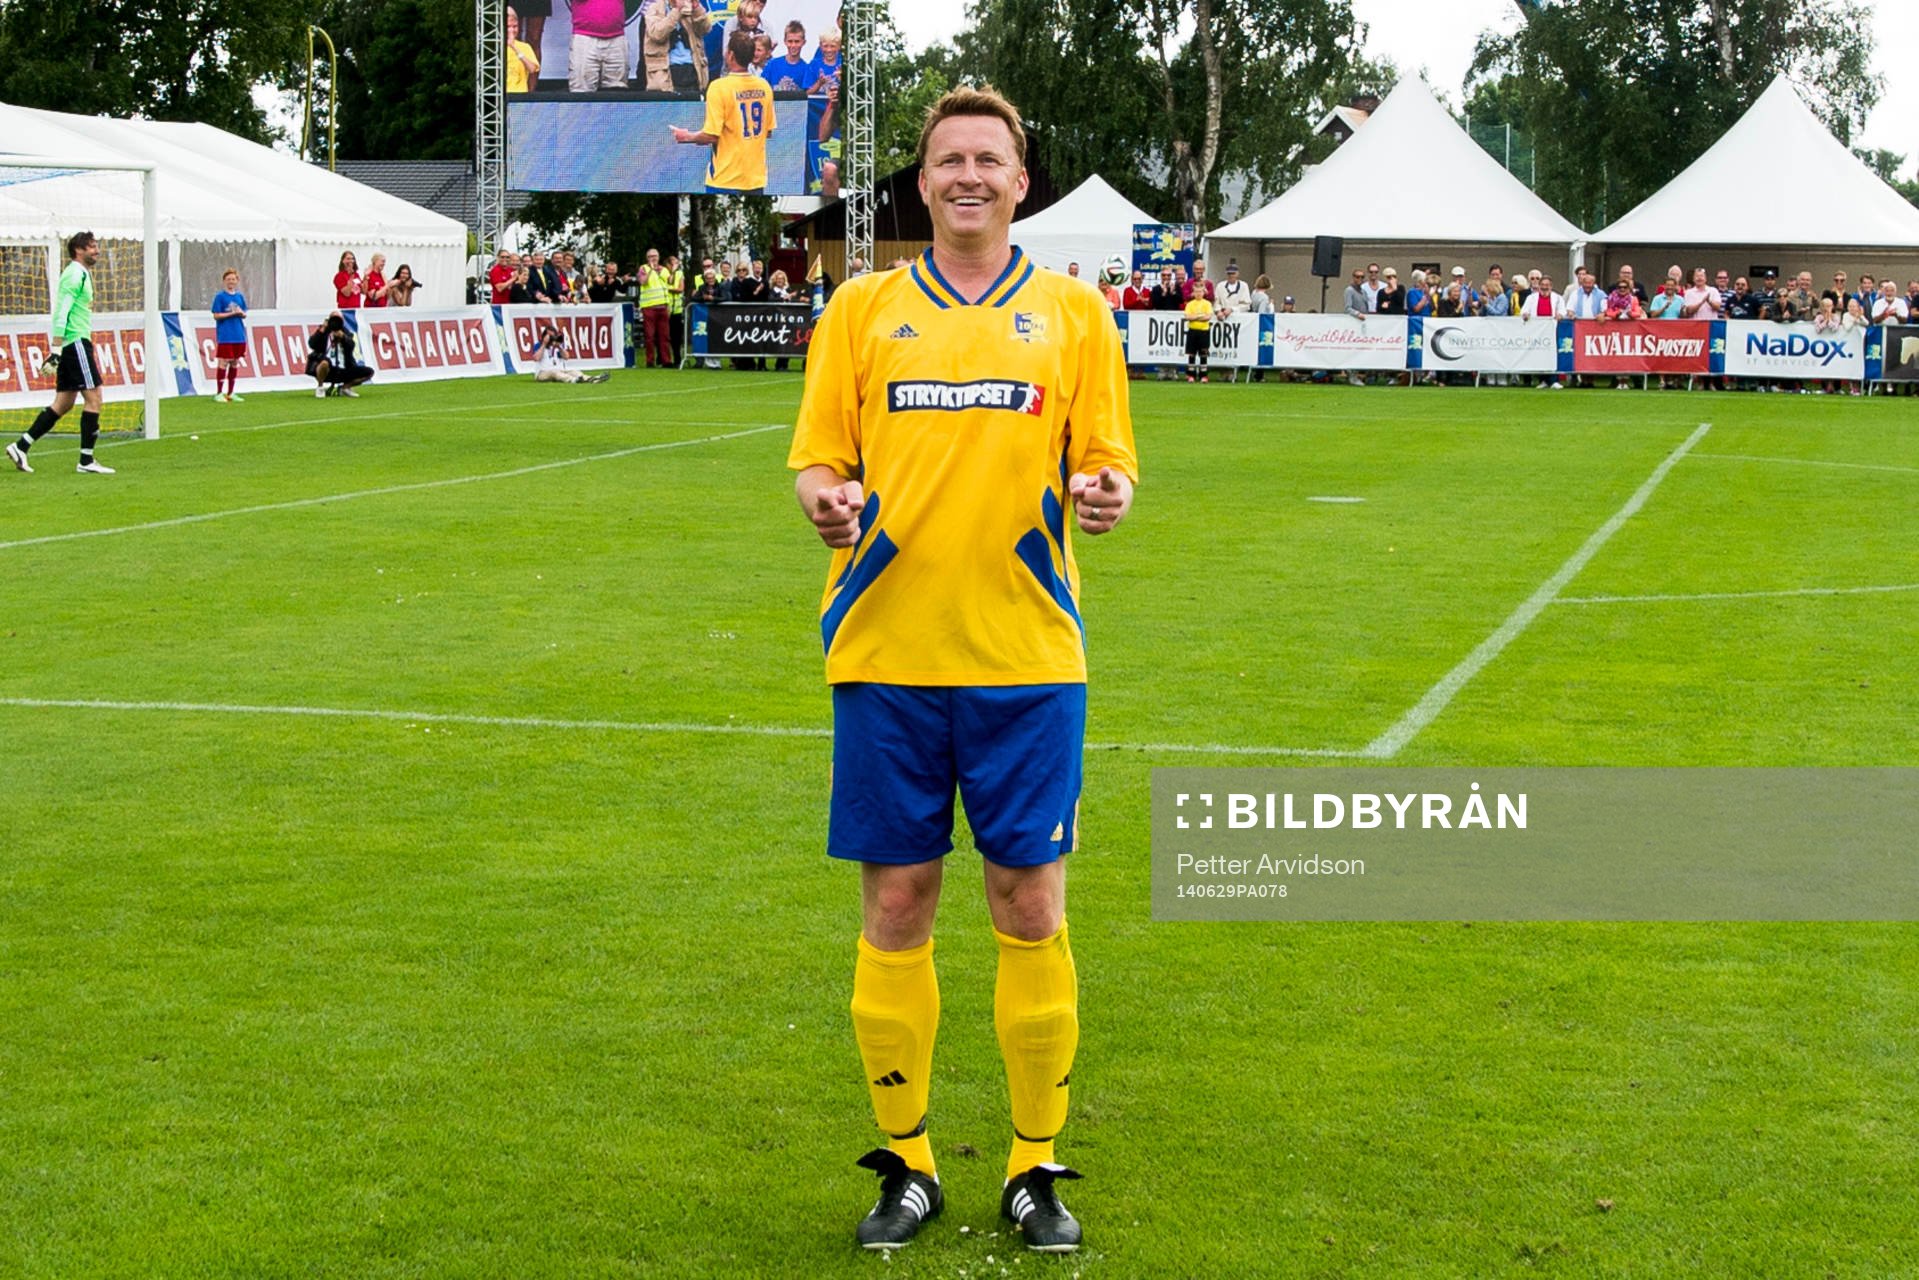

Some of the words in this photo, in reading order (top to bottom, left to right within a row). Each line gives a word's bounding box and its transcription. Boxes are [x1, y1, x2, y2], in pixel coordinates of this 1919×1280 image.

[740, 101, 764, 137] 19
[735, 313, 804, 323] norrviken
[377, 326, 484, 361] CRAMO
[518, 325, 609, 353] CAMO
[1489, 337, 1552, 348] COACHING
[895, 382, 1015, 408] STRYKTIPSET
